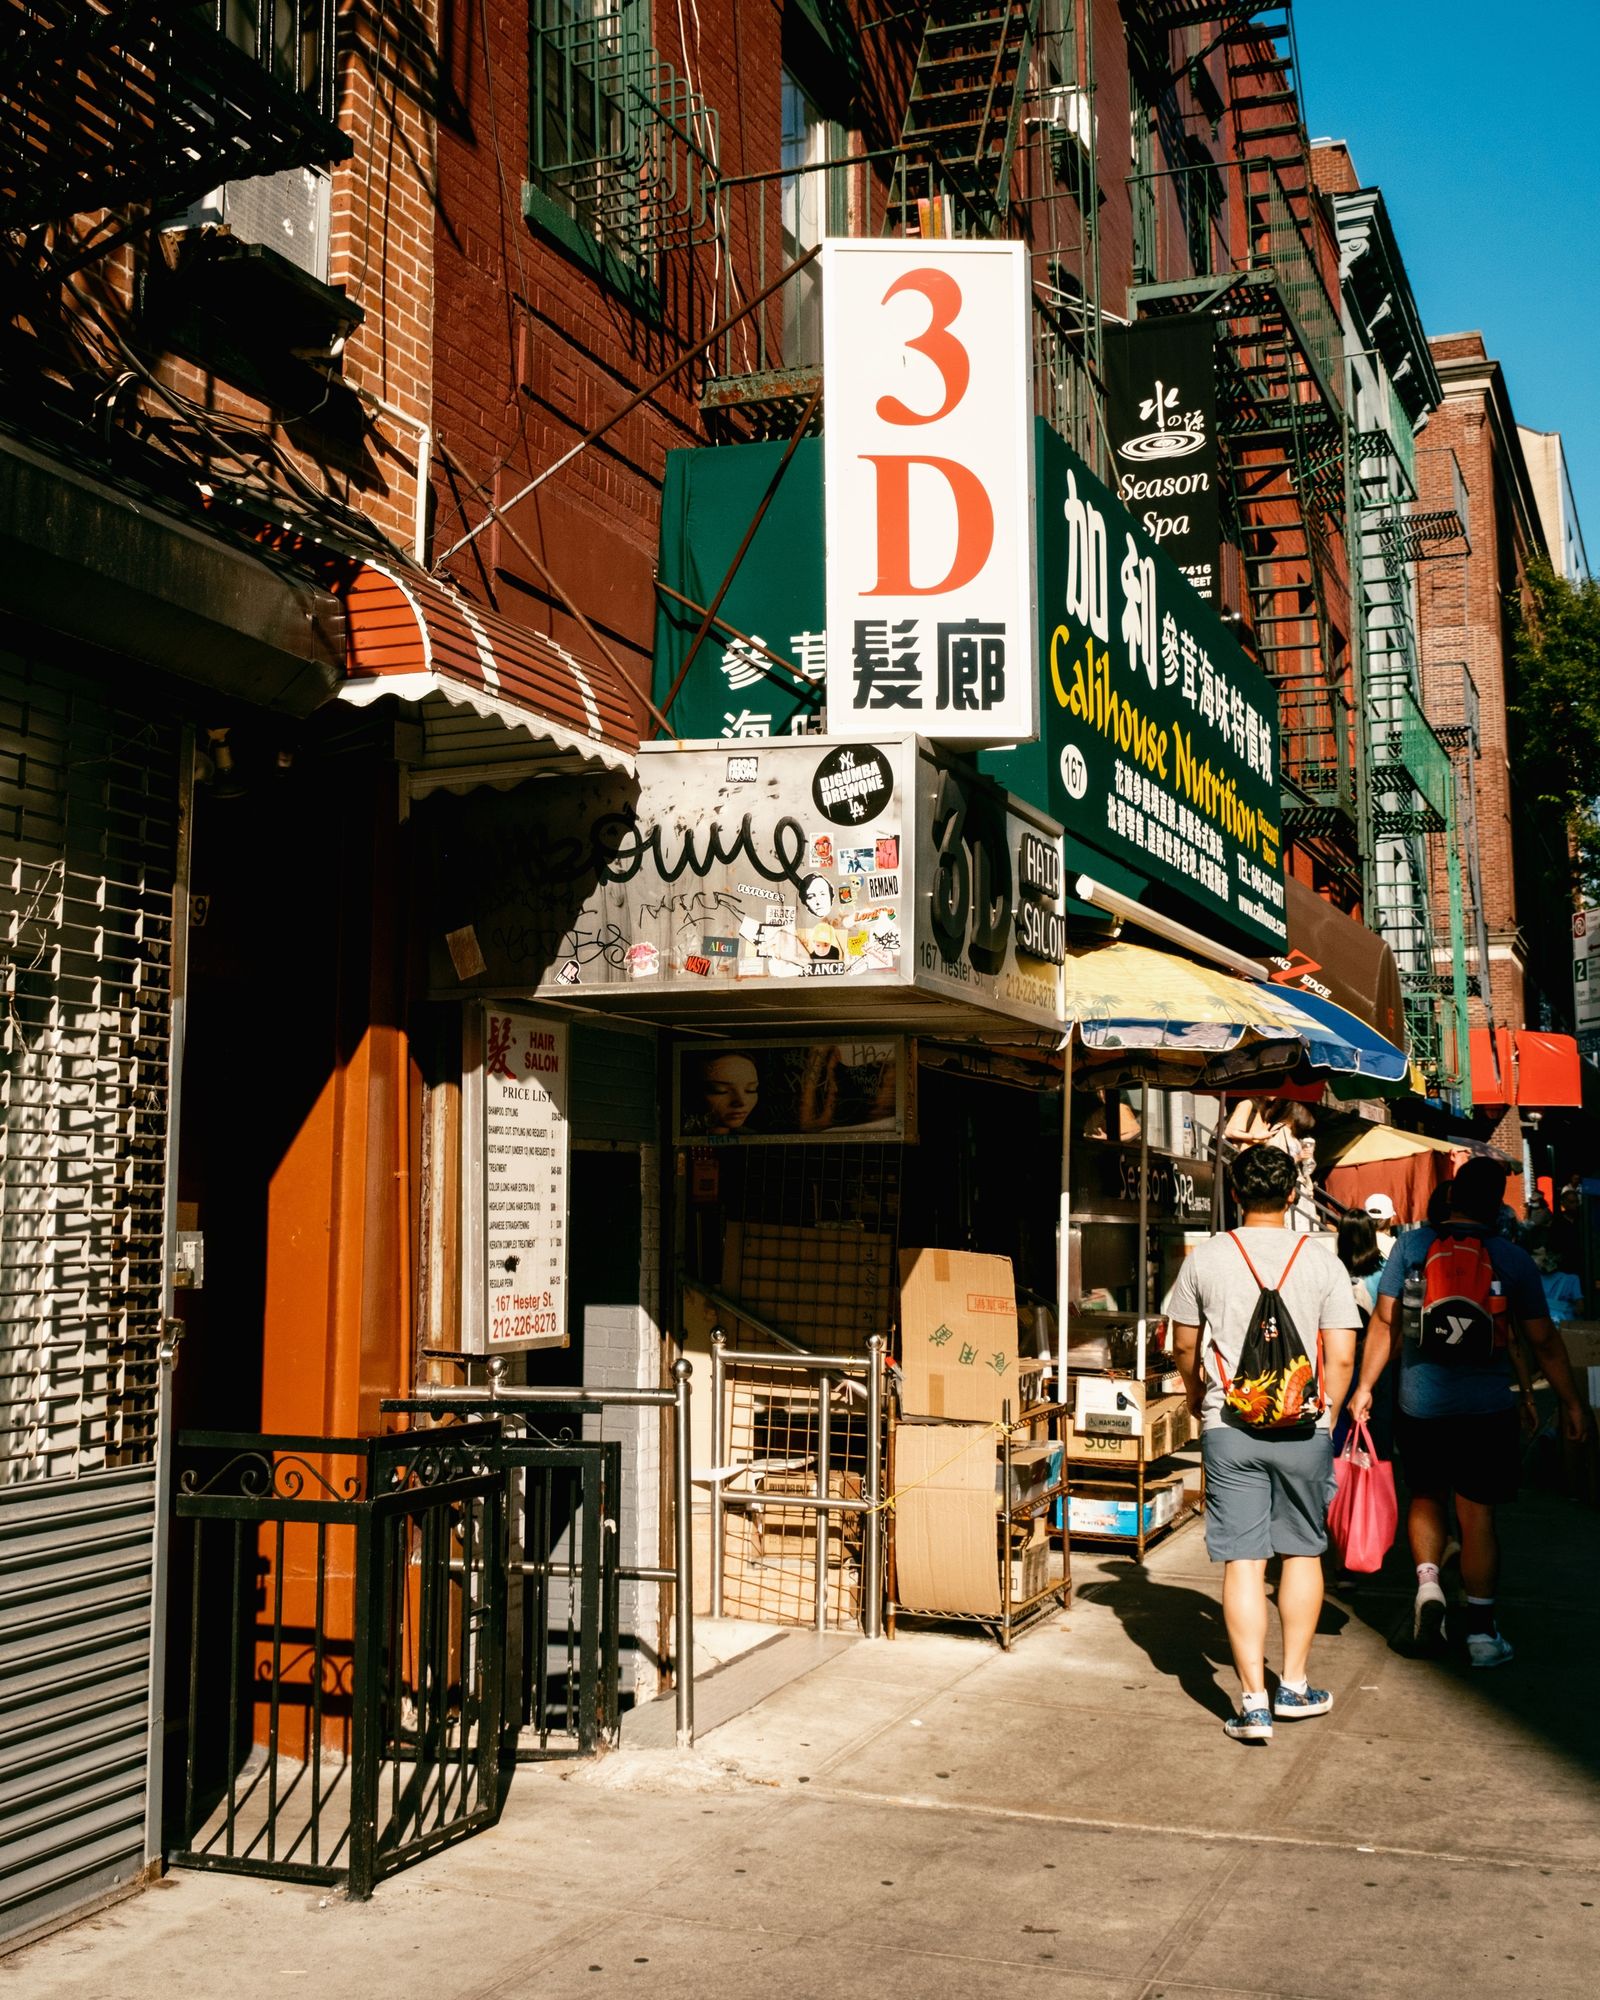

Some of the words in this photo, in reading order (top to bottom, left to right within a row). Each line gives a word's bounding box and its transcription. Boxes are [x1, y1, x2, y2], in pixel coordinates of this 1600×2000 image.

[1117, 472, 1209, 501] Season
[1142, 511, 1190, 545] Spa
[852, 618, 1006, 711] 髮廊
[1050, 624, 1168, 780] Calihouse
[1172, 721, 1257, 852] Nutrition
[819, 761, 881, 792] DJGUMBA
[1064, 753, 1083, 791] 167
[821, 774, 885, 807] DREWONE
[1026, 837, 1060, 896] HAIR
[869, 875, 899, 899] REMAND
[1023, 902, 1066, 963] SALON
[686, 956, 711, 976] NASTY
[920, 941, 938, 970] 167
[1577, 961, 1585, 980] 2
[1299, 973, 1332, 999] EDGE
[529, 1031, 555, 1051] HAIR
[524, 1051, 559, 1073] SALON
[502, 1086, 530, 1101] PRICE
[532, 1089, 552, 1103] LIST
[496, 1295, 511, 1312] 167
[513, 1293, 540, 1310] Hester
[542, 1291, 554, 1308] St.
[493, 1312, 557, 1339] 212-226-8278
[1435, 1327, 1448, 1335] the
[1098, 1420, 1130, 1428] HANDICAP
